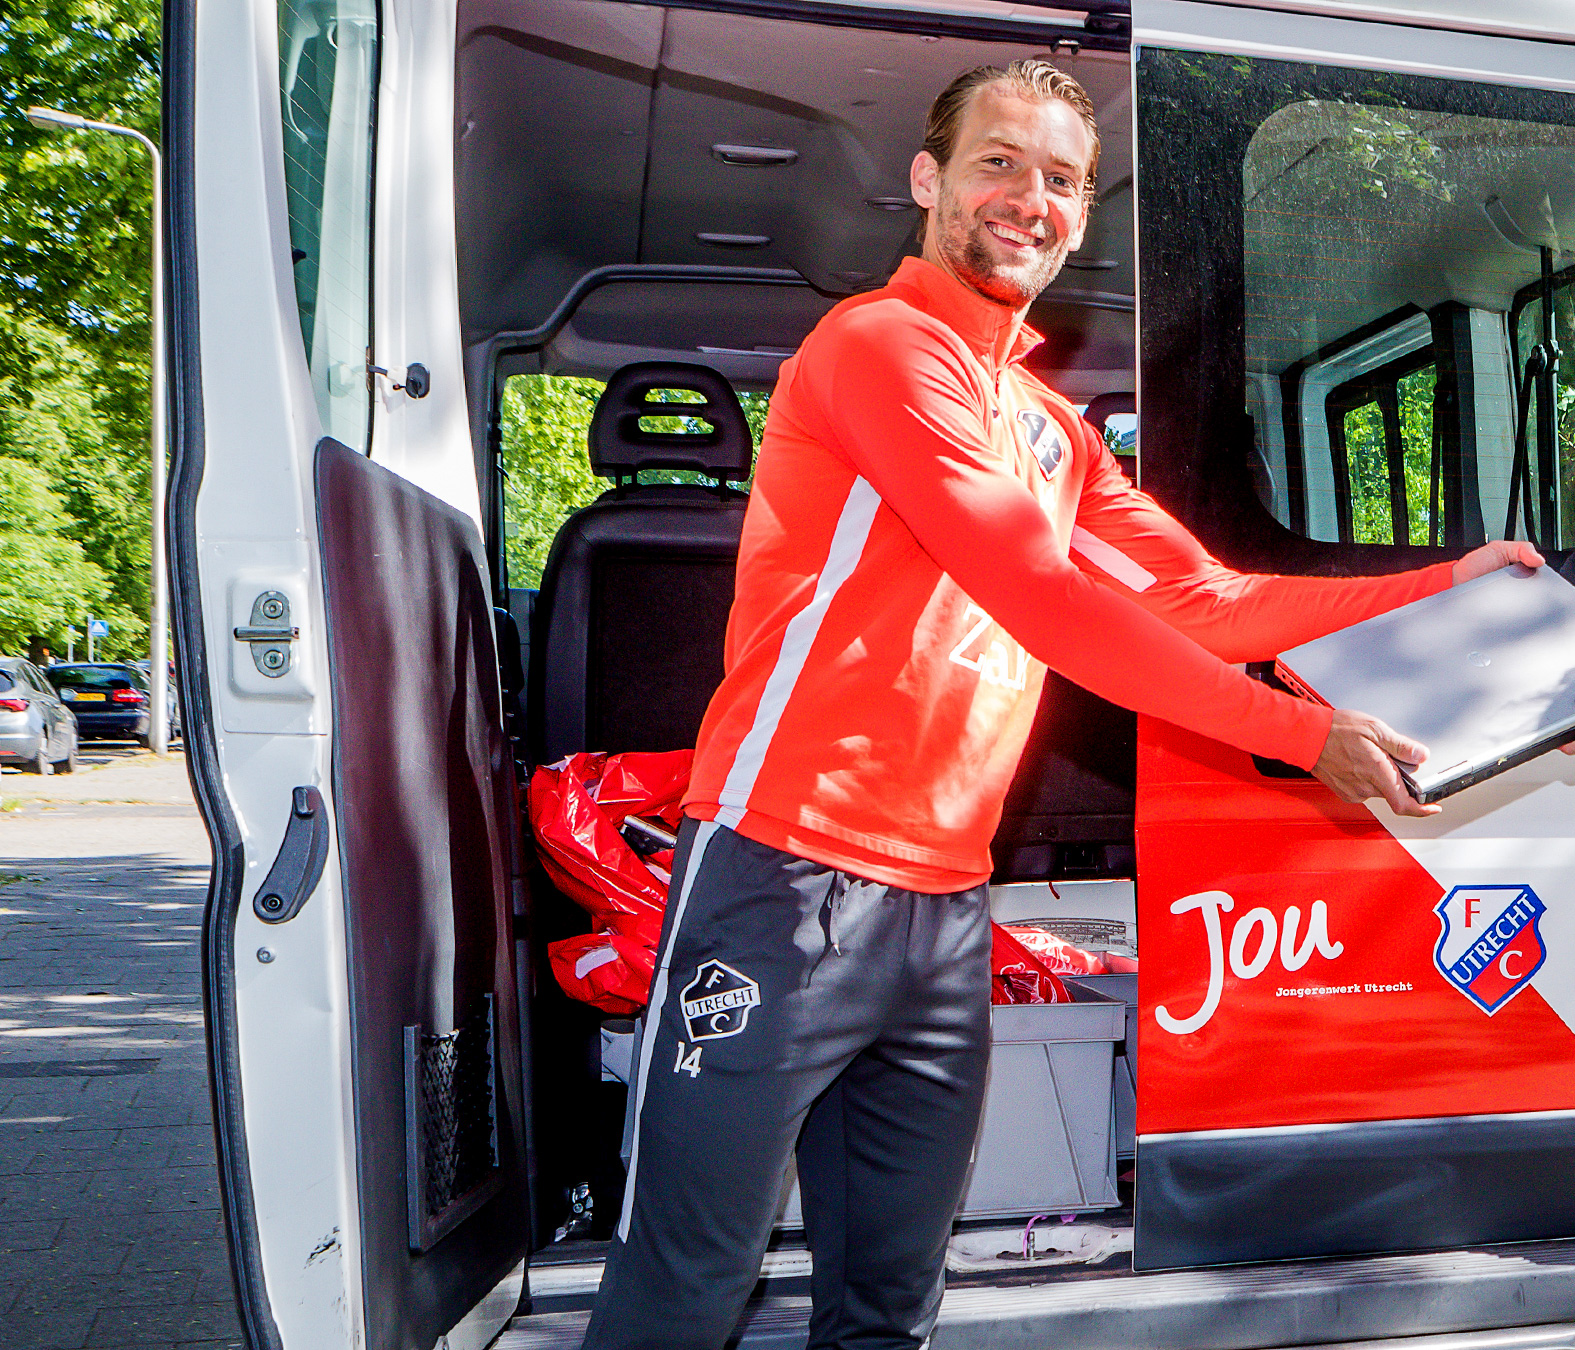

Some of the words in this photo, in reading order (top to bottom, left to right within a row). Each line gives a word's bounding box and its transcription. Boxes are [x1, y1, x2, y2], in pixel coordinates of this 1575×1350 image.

[1464, 898, 1481, 929] F
[1451, 893, 1536, 985] UTRECHT
[705, 969, 725, 989] F
[1498, 949, 1523, 980] C
[684, 988, 754, 1018] UTRECHT
[1275, 983, 1361, 998] Jongerenwerk
[1364, 981, 1414, 993] Utrecht
[709, 1012, 731, 1033] C
[673, 1041, 703, 1079] 14
